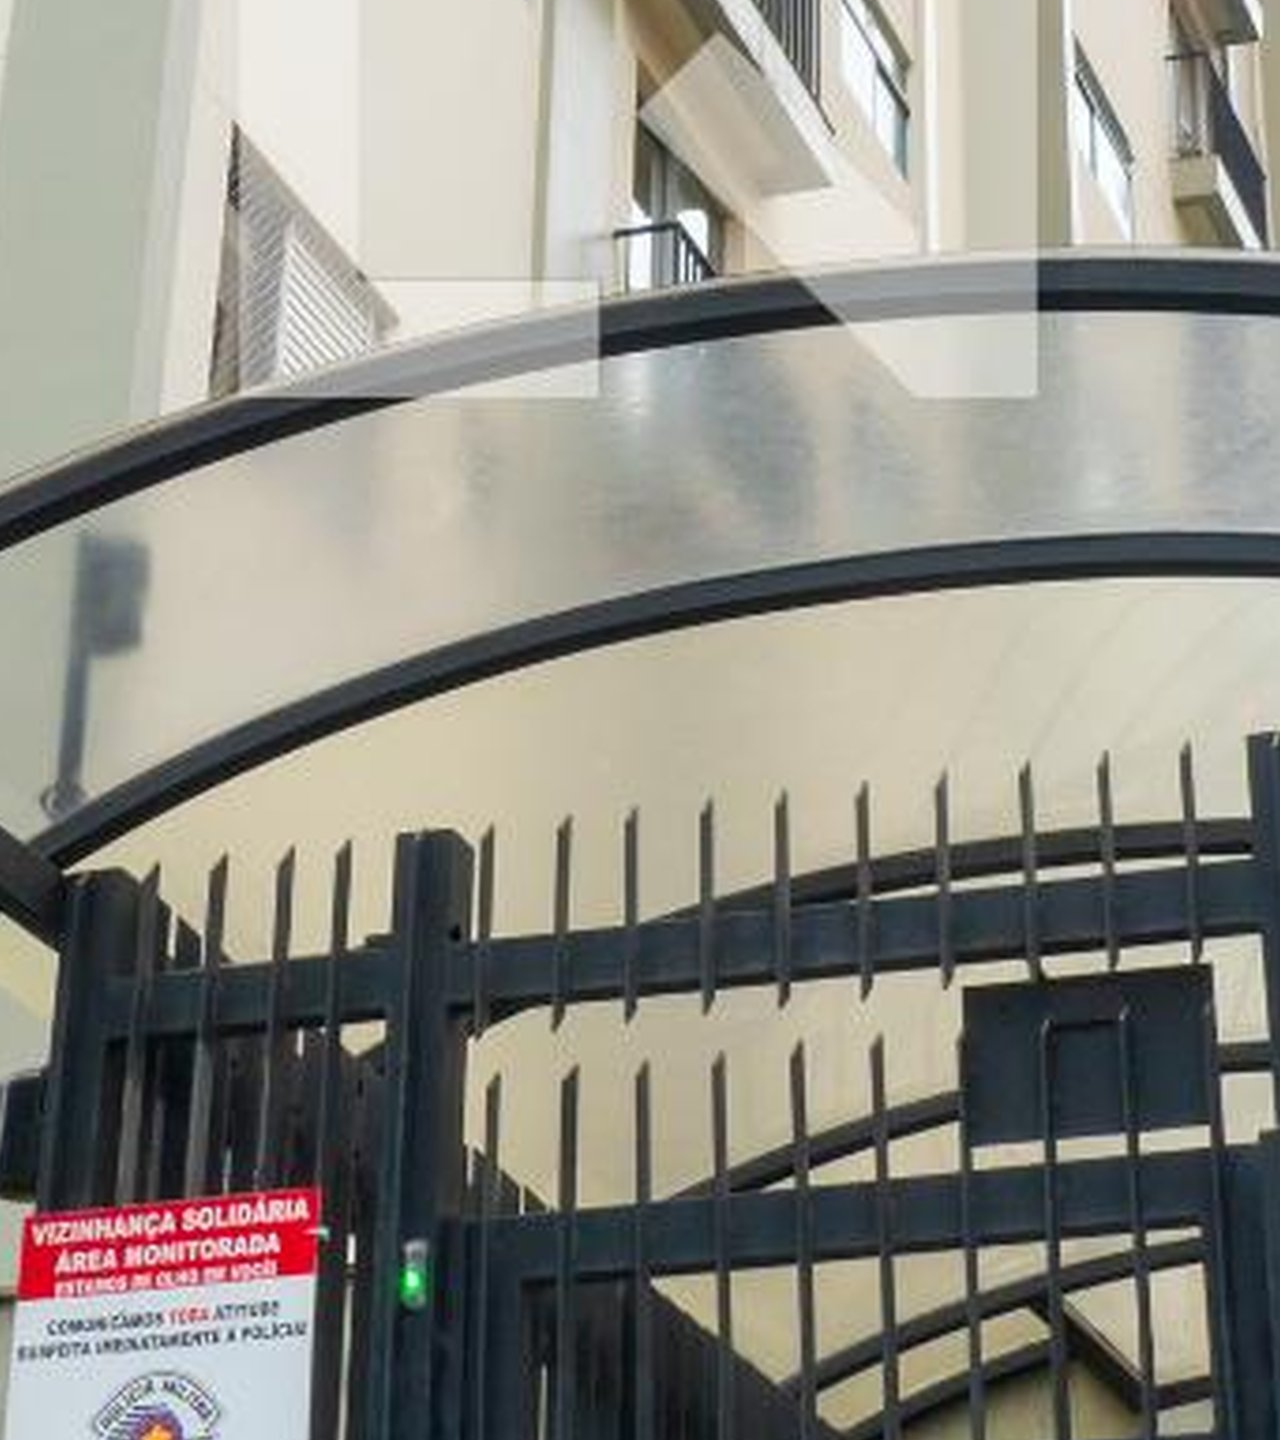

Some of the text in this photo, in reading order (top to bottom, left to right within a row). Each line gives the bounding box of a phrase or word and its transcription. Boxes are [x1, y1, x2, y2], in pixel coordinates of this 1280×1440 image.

[31, 1196, 310, 1246] VIZINHANÇA SOLIDÁRIA
[55, 1232, 281, 1274] ÁREA MONITORADA
